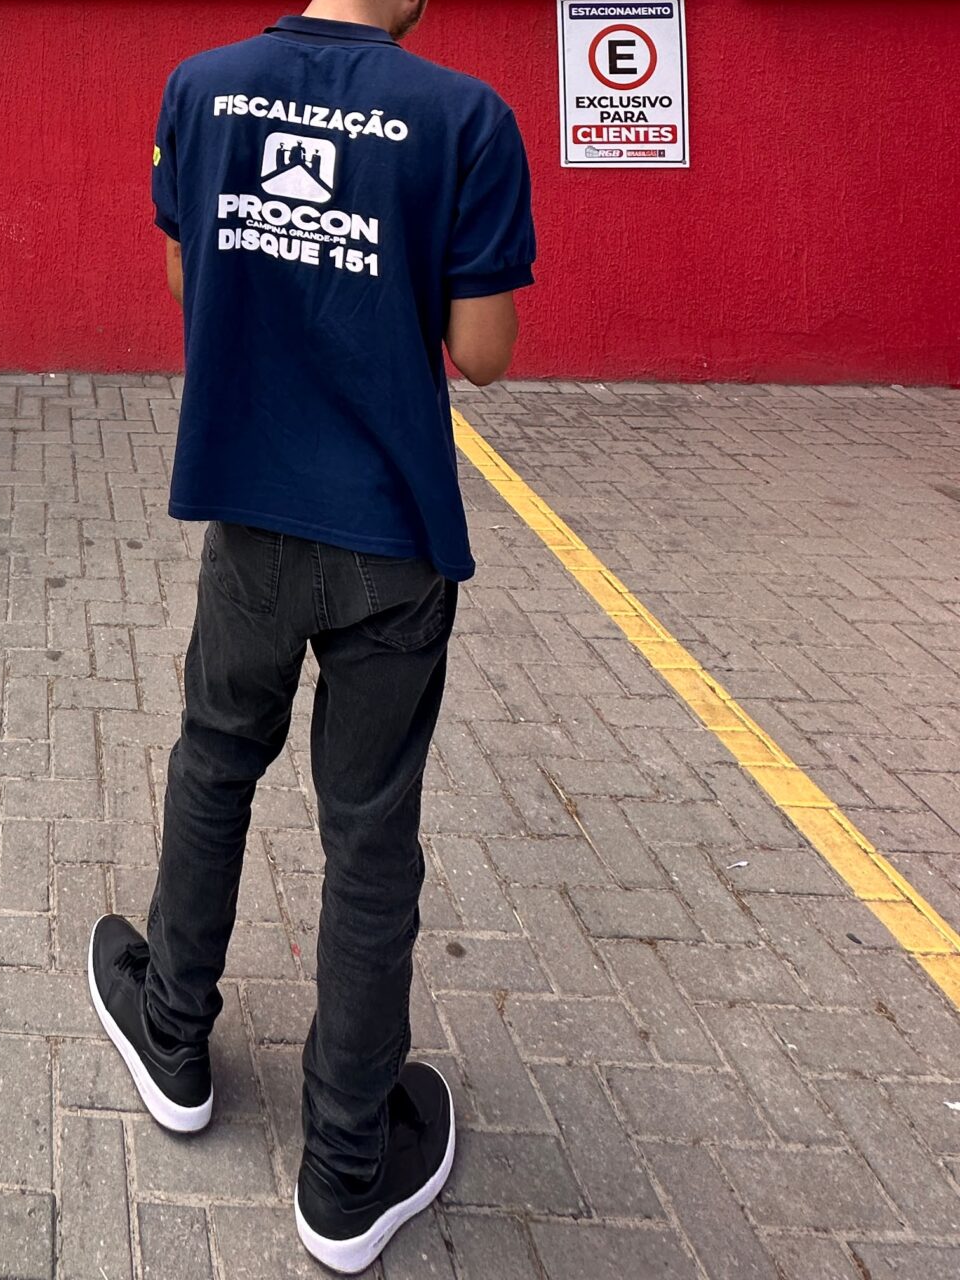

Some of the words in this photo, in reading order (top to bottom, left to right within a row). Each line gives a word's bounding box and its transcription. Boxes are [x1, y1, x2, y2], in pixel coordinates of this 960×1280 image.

[571, 6, 671, 16] ESTACIONAMENTO
[608, 40, 637, 74] E
[575, 96, 672, 109] EXCLUSIVO
[214, 94, 408, 141] FISCALIZAÇÃO
[600, 111, 648, 123] PARA
[577, 127, 673, 143] CLIENTES
[218, 194, 378, 244] PROCON
[246, 219, 287, 235] CAMPINA
[218, 228, 319, 265] DISQUE
[329, 246, 378, 276] 151
